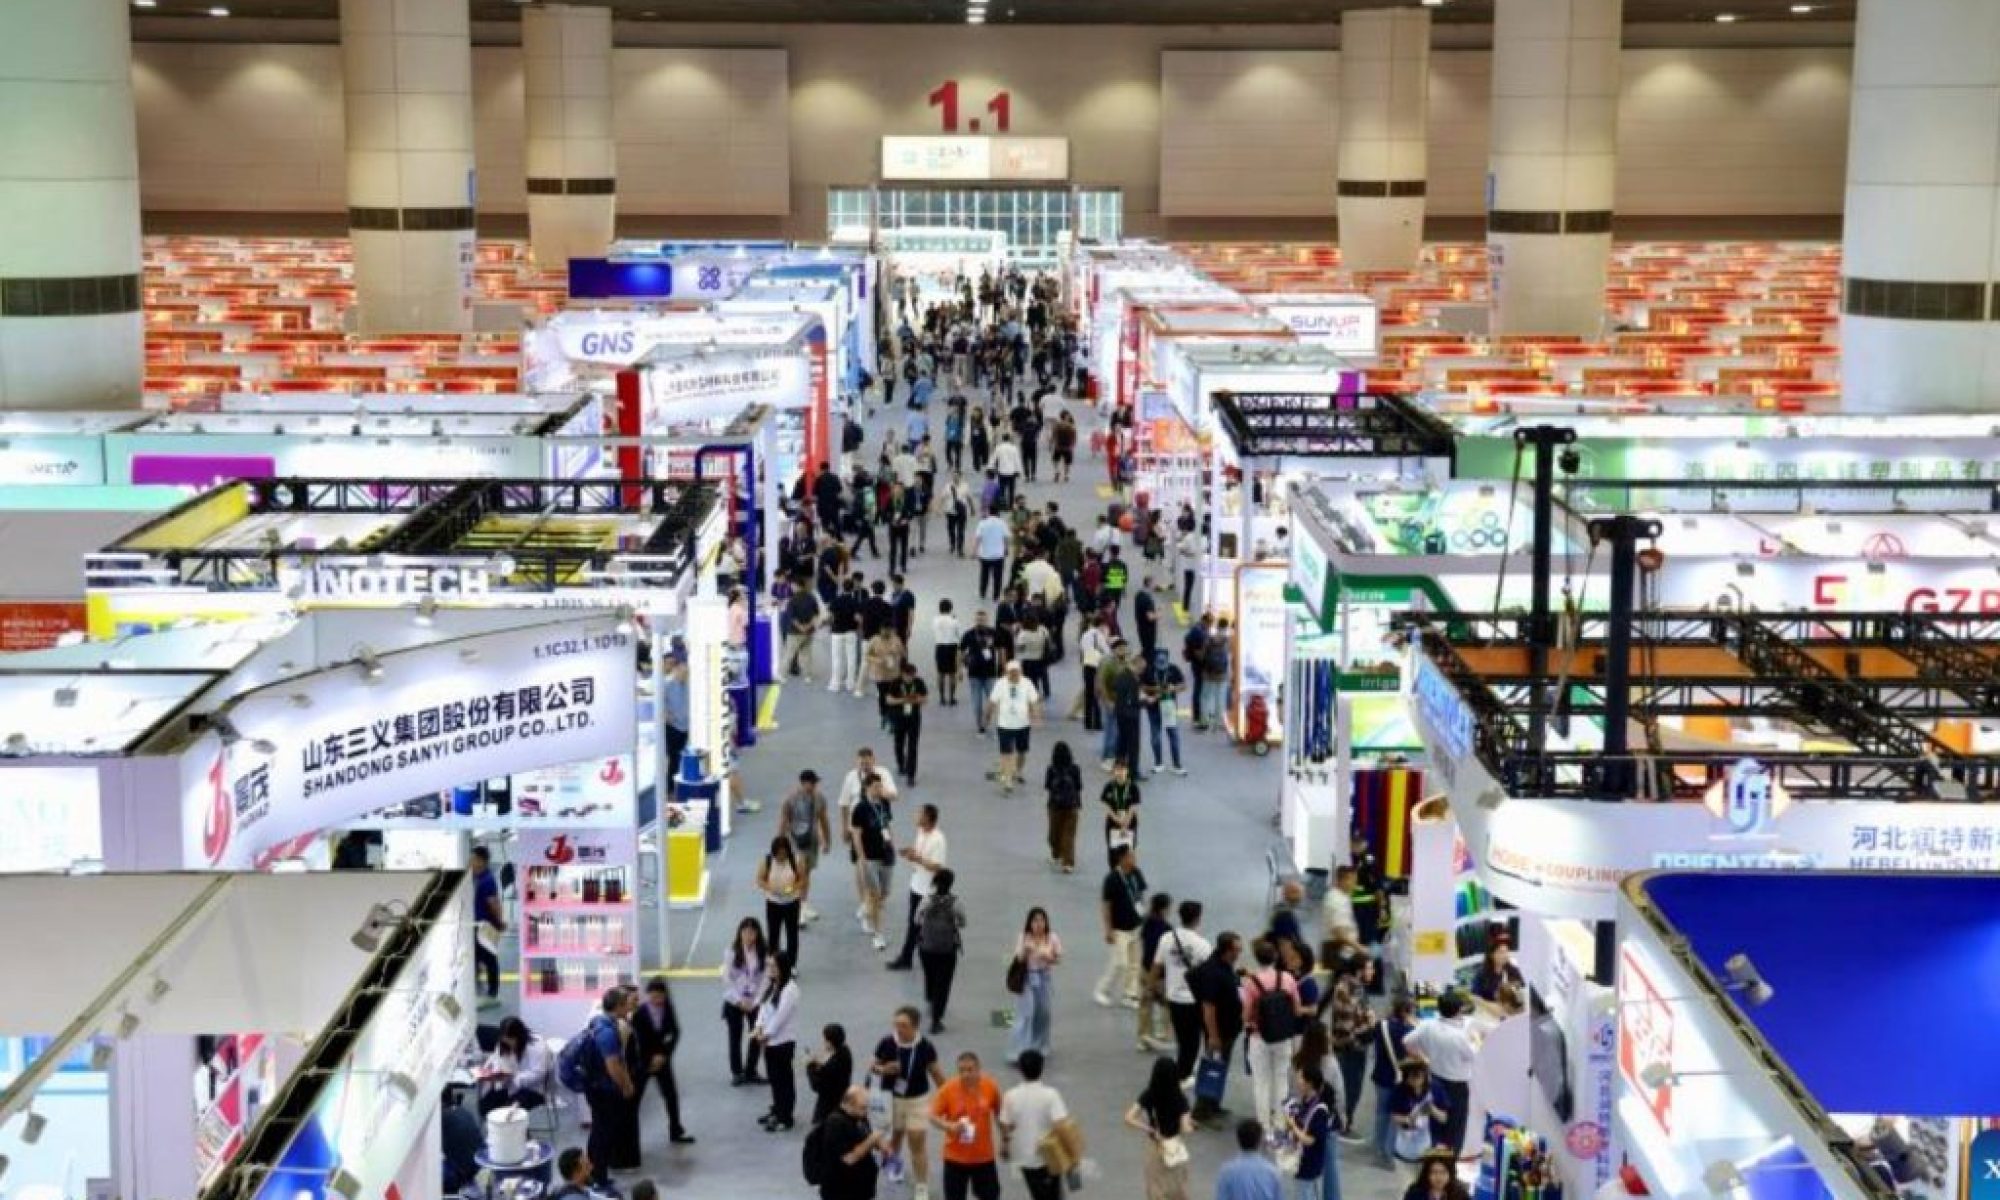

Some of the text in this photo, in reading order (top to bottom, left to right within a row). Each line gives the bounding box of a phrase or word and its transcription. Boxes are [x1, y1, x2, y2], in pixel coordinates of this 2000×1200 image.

[929, 80, 1010, 132] 1.1
[581, 332, 635, 355] GNS
[303, 676, 594, 772] 山东三义集团股份有限公司
[303, 755, 393, 798] SHANDONG
[397, 743, 449, 769] SANYI
[454, 725, 514, 753] GROUP
[1850, 825, 2000, 851] 河北润特新
